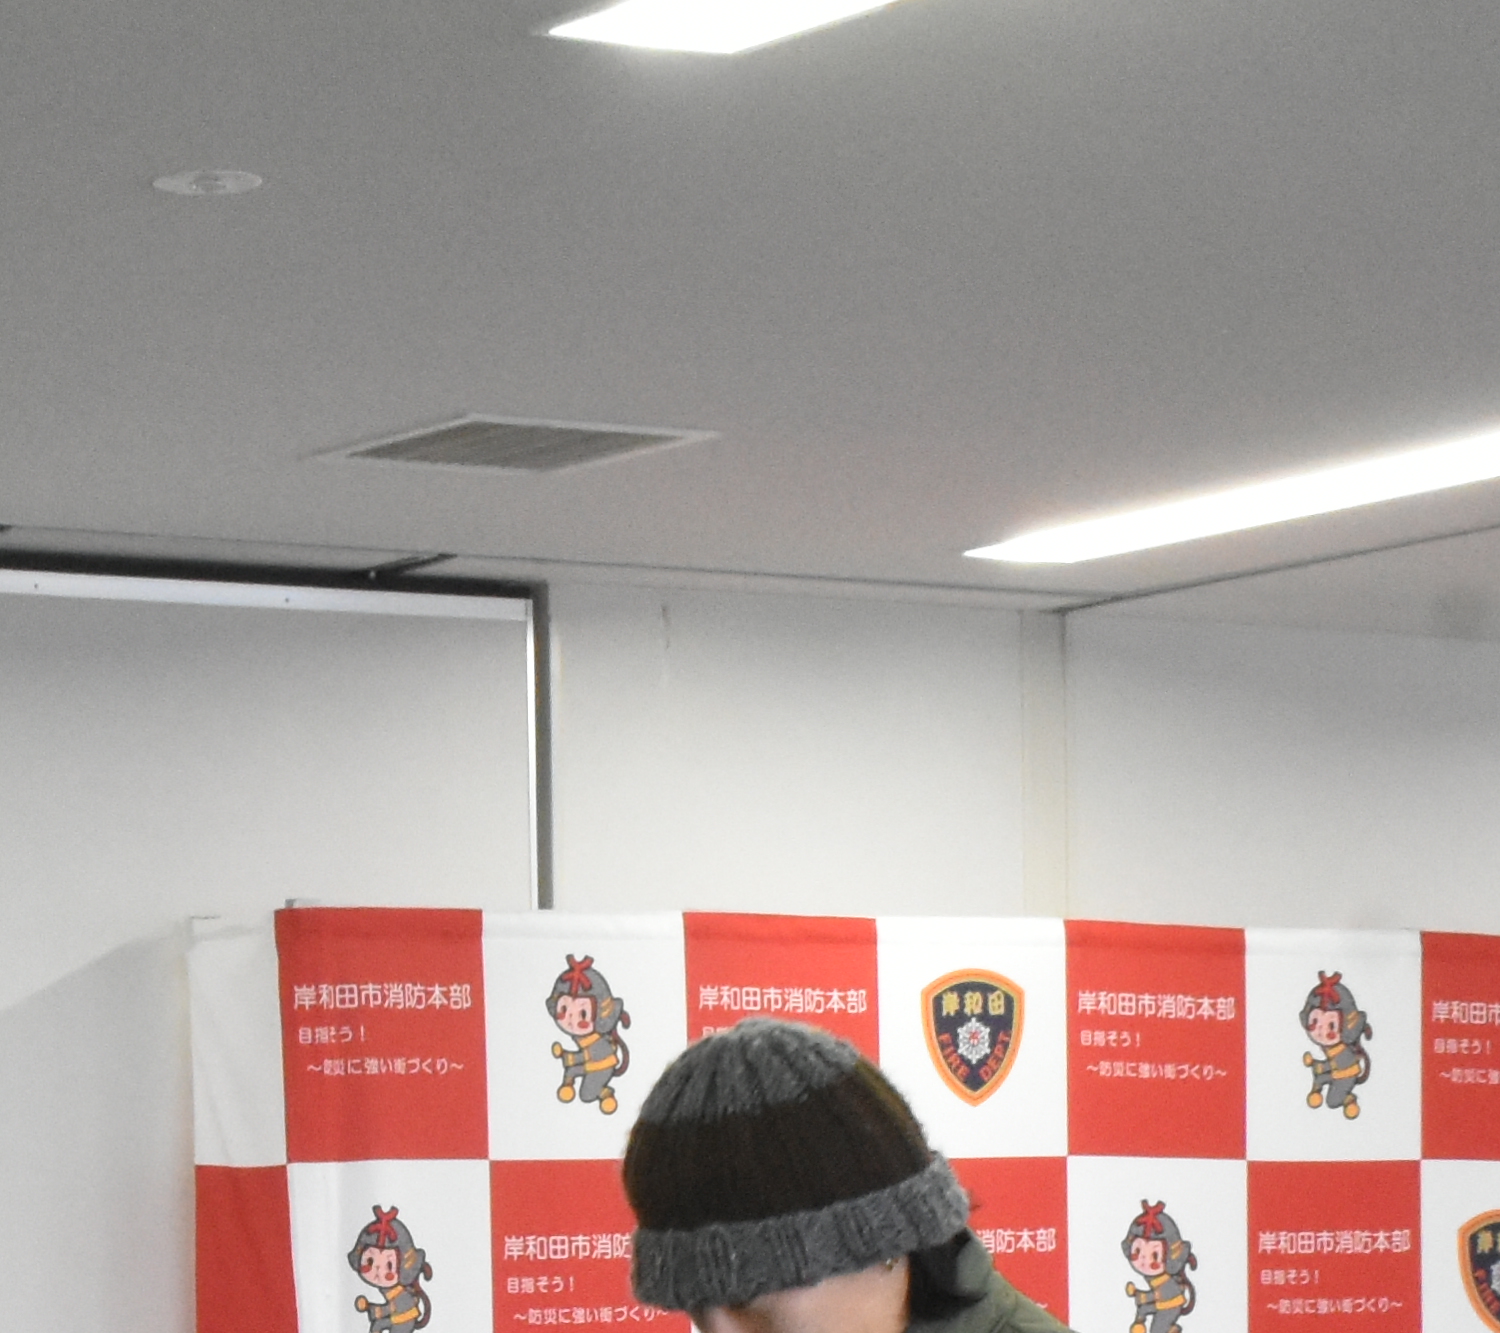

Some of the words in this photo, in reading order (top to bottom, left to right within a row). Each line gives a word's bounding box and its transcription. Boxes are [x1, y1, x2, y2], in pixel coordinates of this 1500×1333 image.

[293, 982, 472, 1011] 岸和田市消防本部
[699, 984, 867, 1014] 岸和田市消防本部
[1077, 990, 1235, 1021] 岸和田市消防本部
[1080, 1029, 1141, 1047] 目指そう！
[503, 1233, 632, 1261] 岸和田市消防
[1258, 1229, 1411, 1254] 岸和田市消防本部
[507, 1276, 575, 1293] 目指そう！
